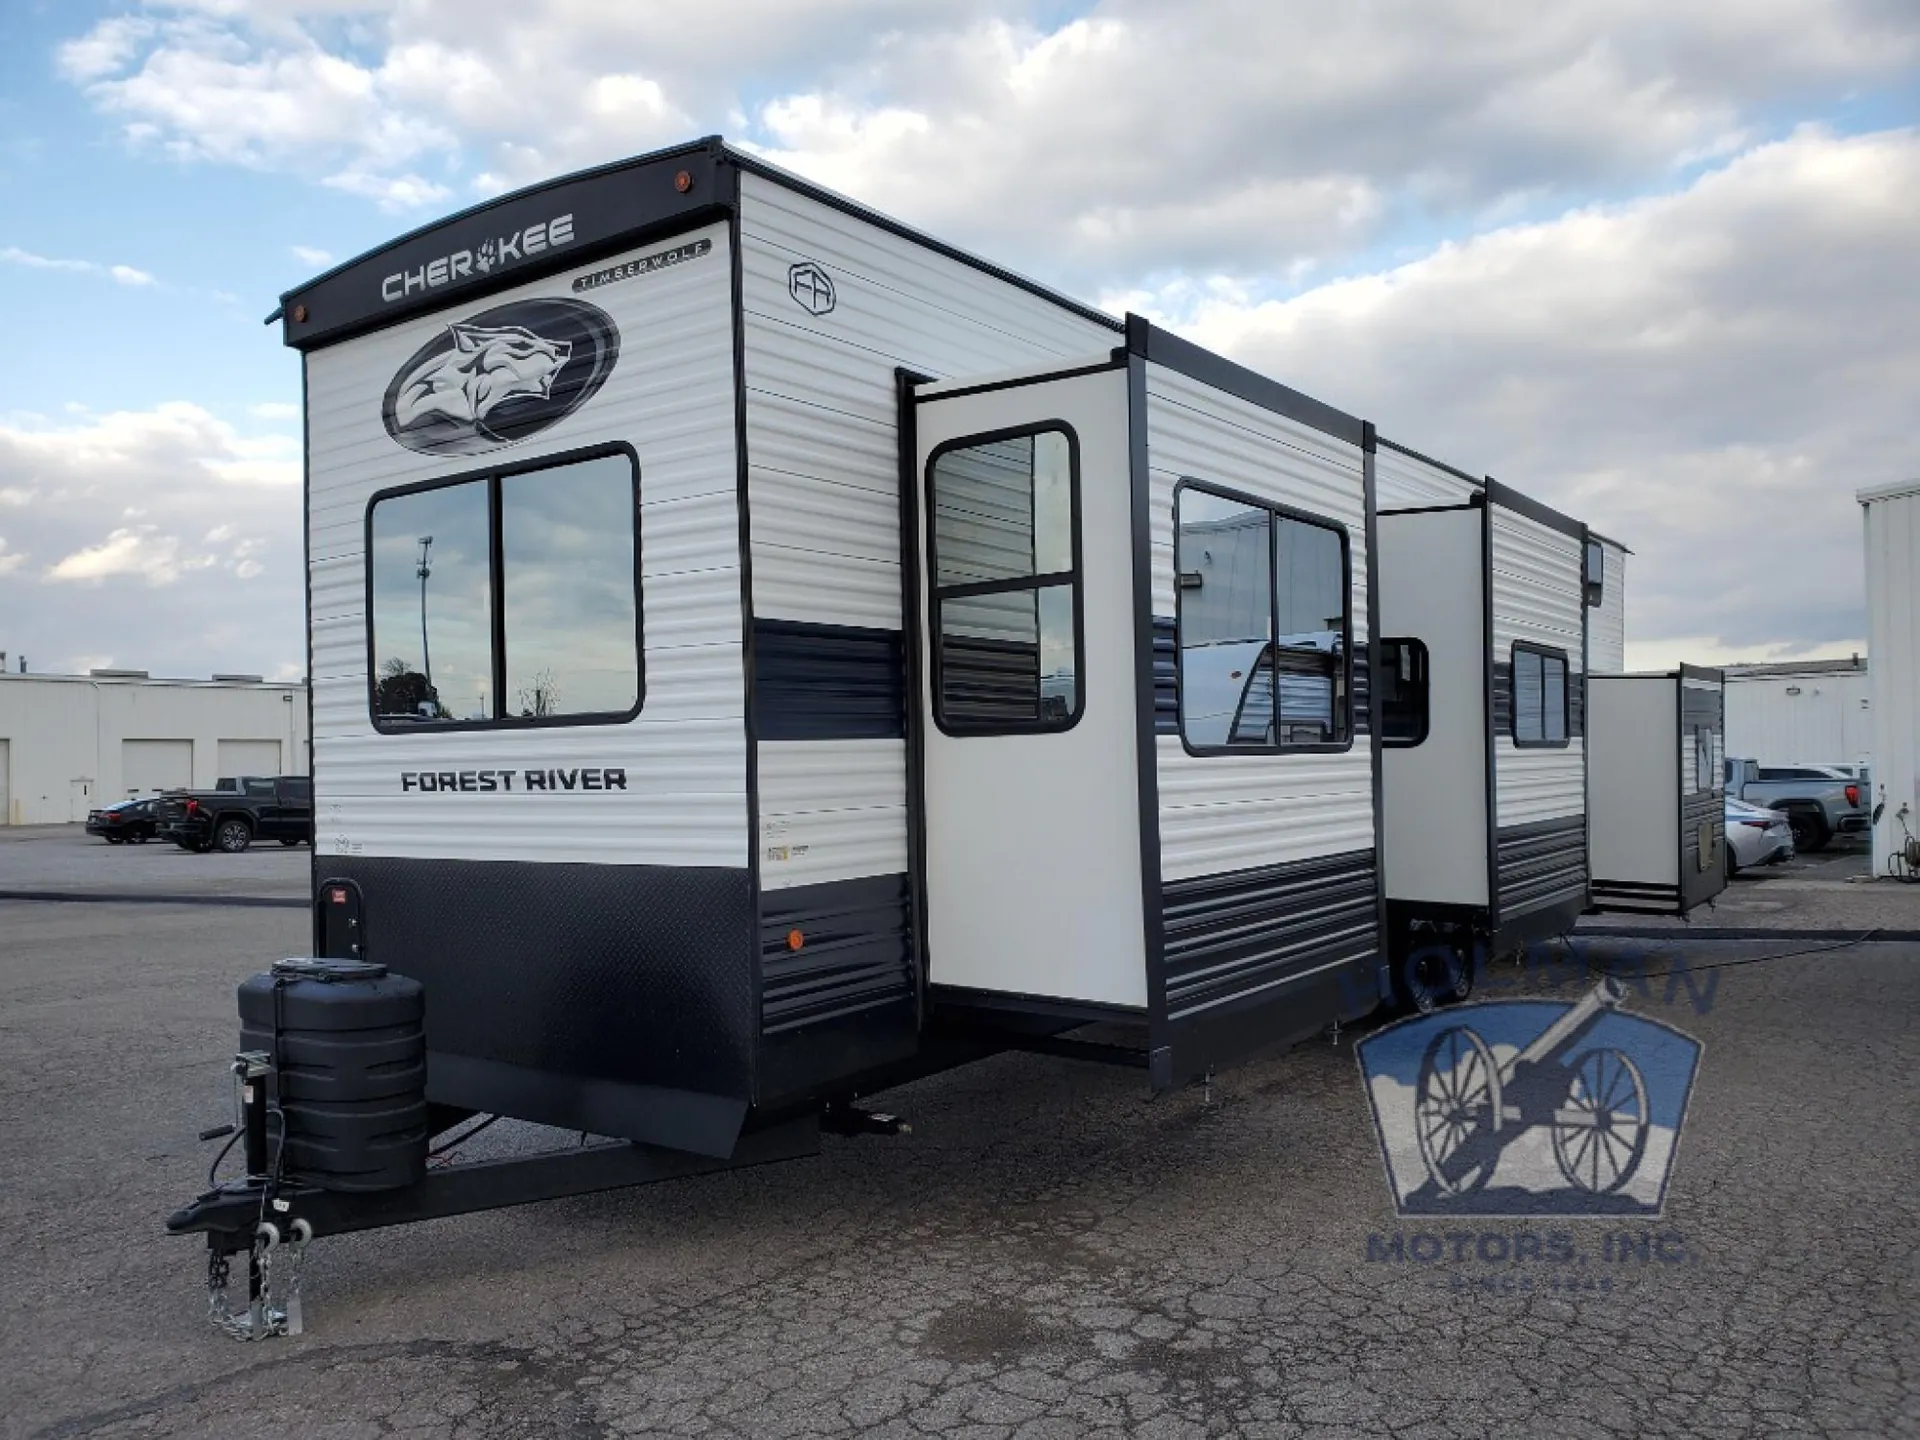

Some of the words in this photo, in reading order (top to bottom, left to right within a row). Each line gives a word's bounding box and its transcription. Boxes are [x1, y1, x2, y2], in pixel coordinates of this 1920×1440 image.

[580, 243, 703, 288] TIMBERWOLF
[401, 770, 516, 792] FOREST
[524, 768, 628, 791] RIVER
